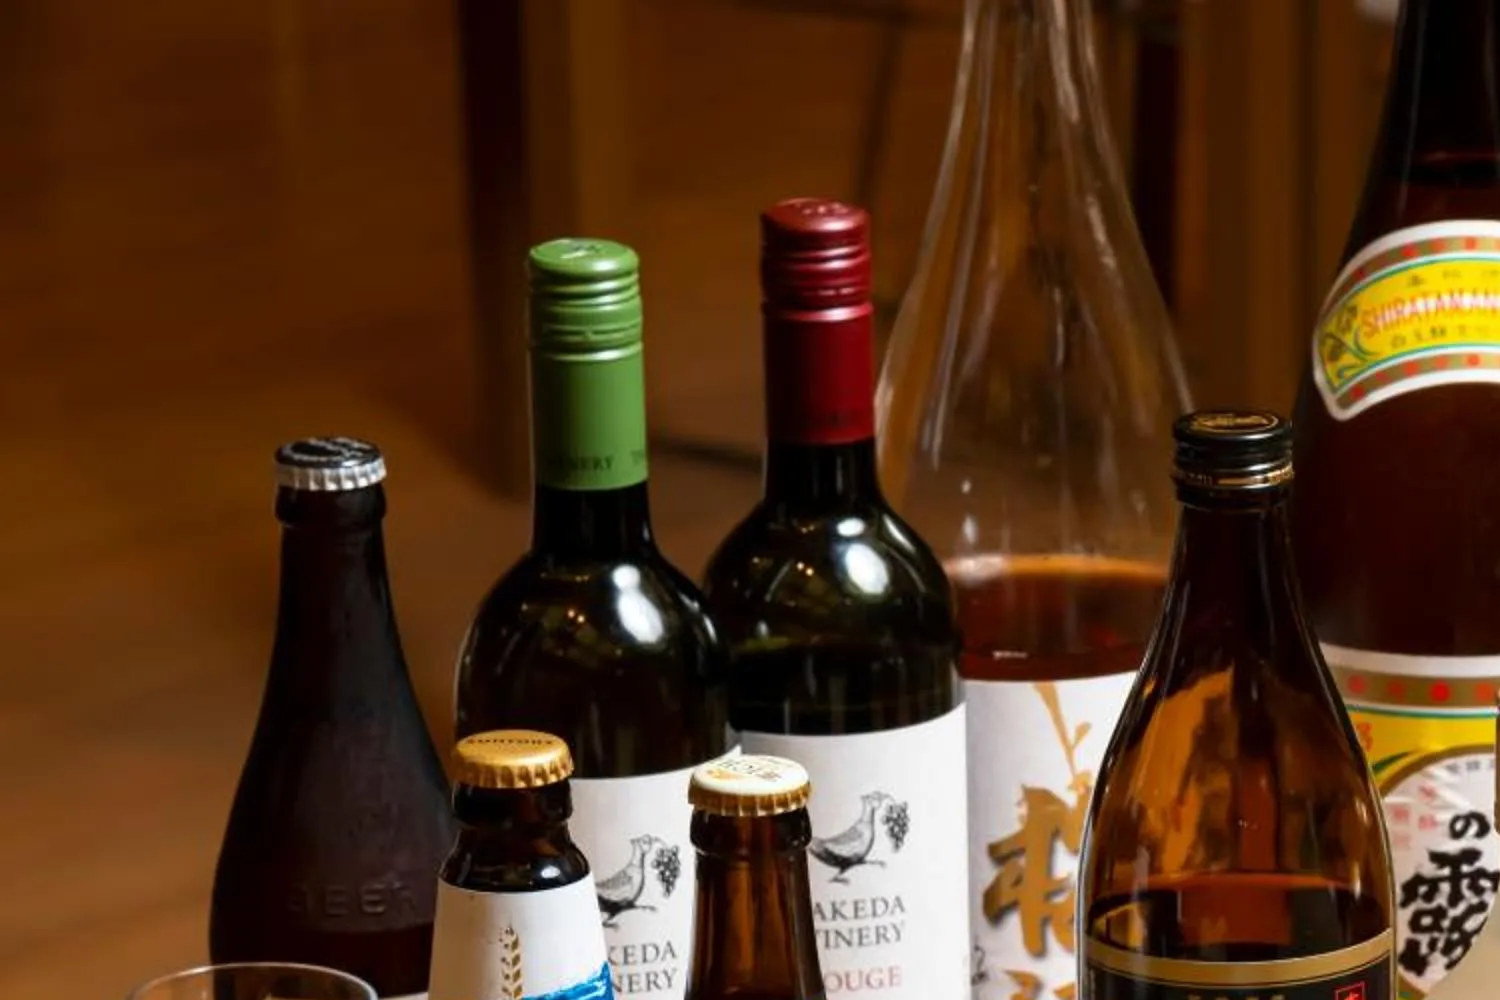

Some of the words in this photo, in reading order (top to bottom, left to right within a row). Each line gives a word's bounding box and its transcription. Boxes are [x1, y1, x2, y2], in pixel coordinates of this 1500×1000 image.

[811, 895, 906, 923] AKEDA
[607, 941, 677, 967] KEDA
[611, 968, 678, 995] NERY
[826, 968, 902, 994] OUGE
